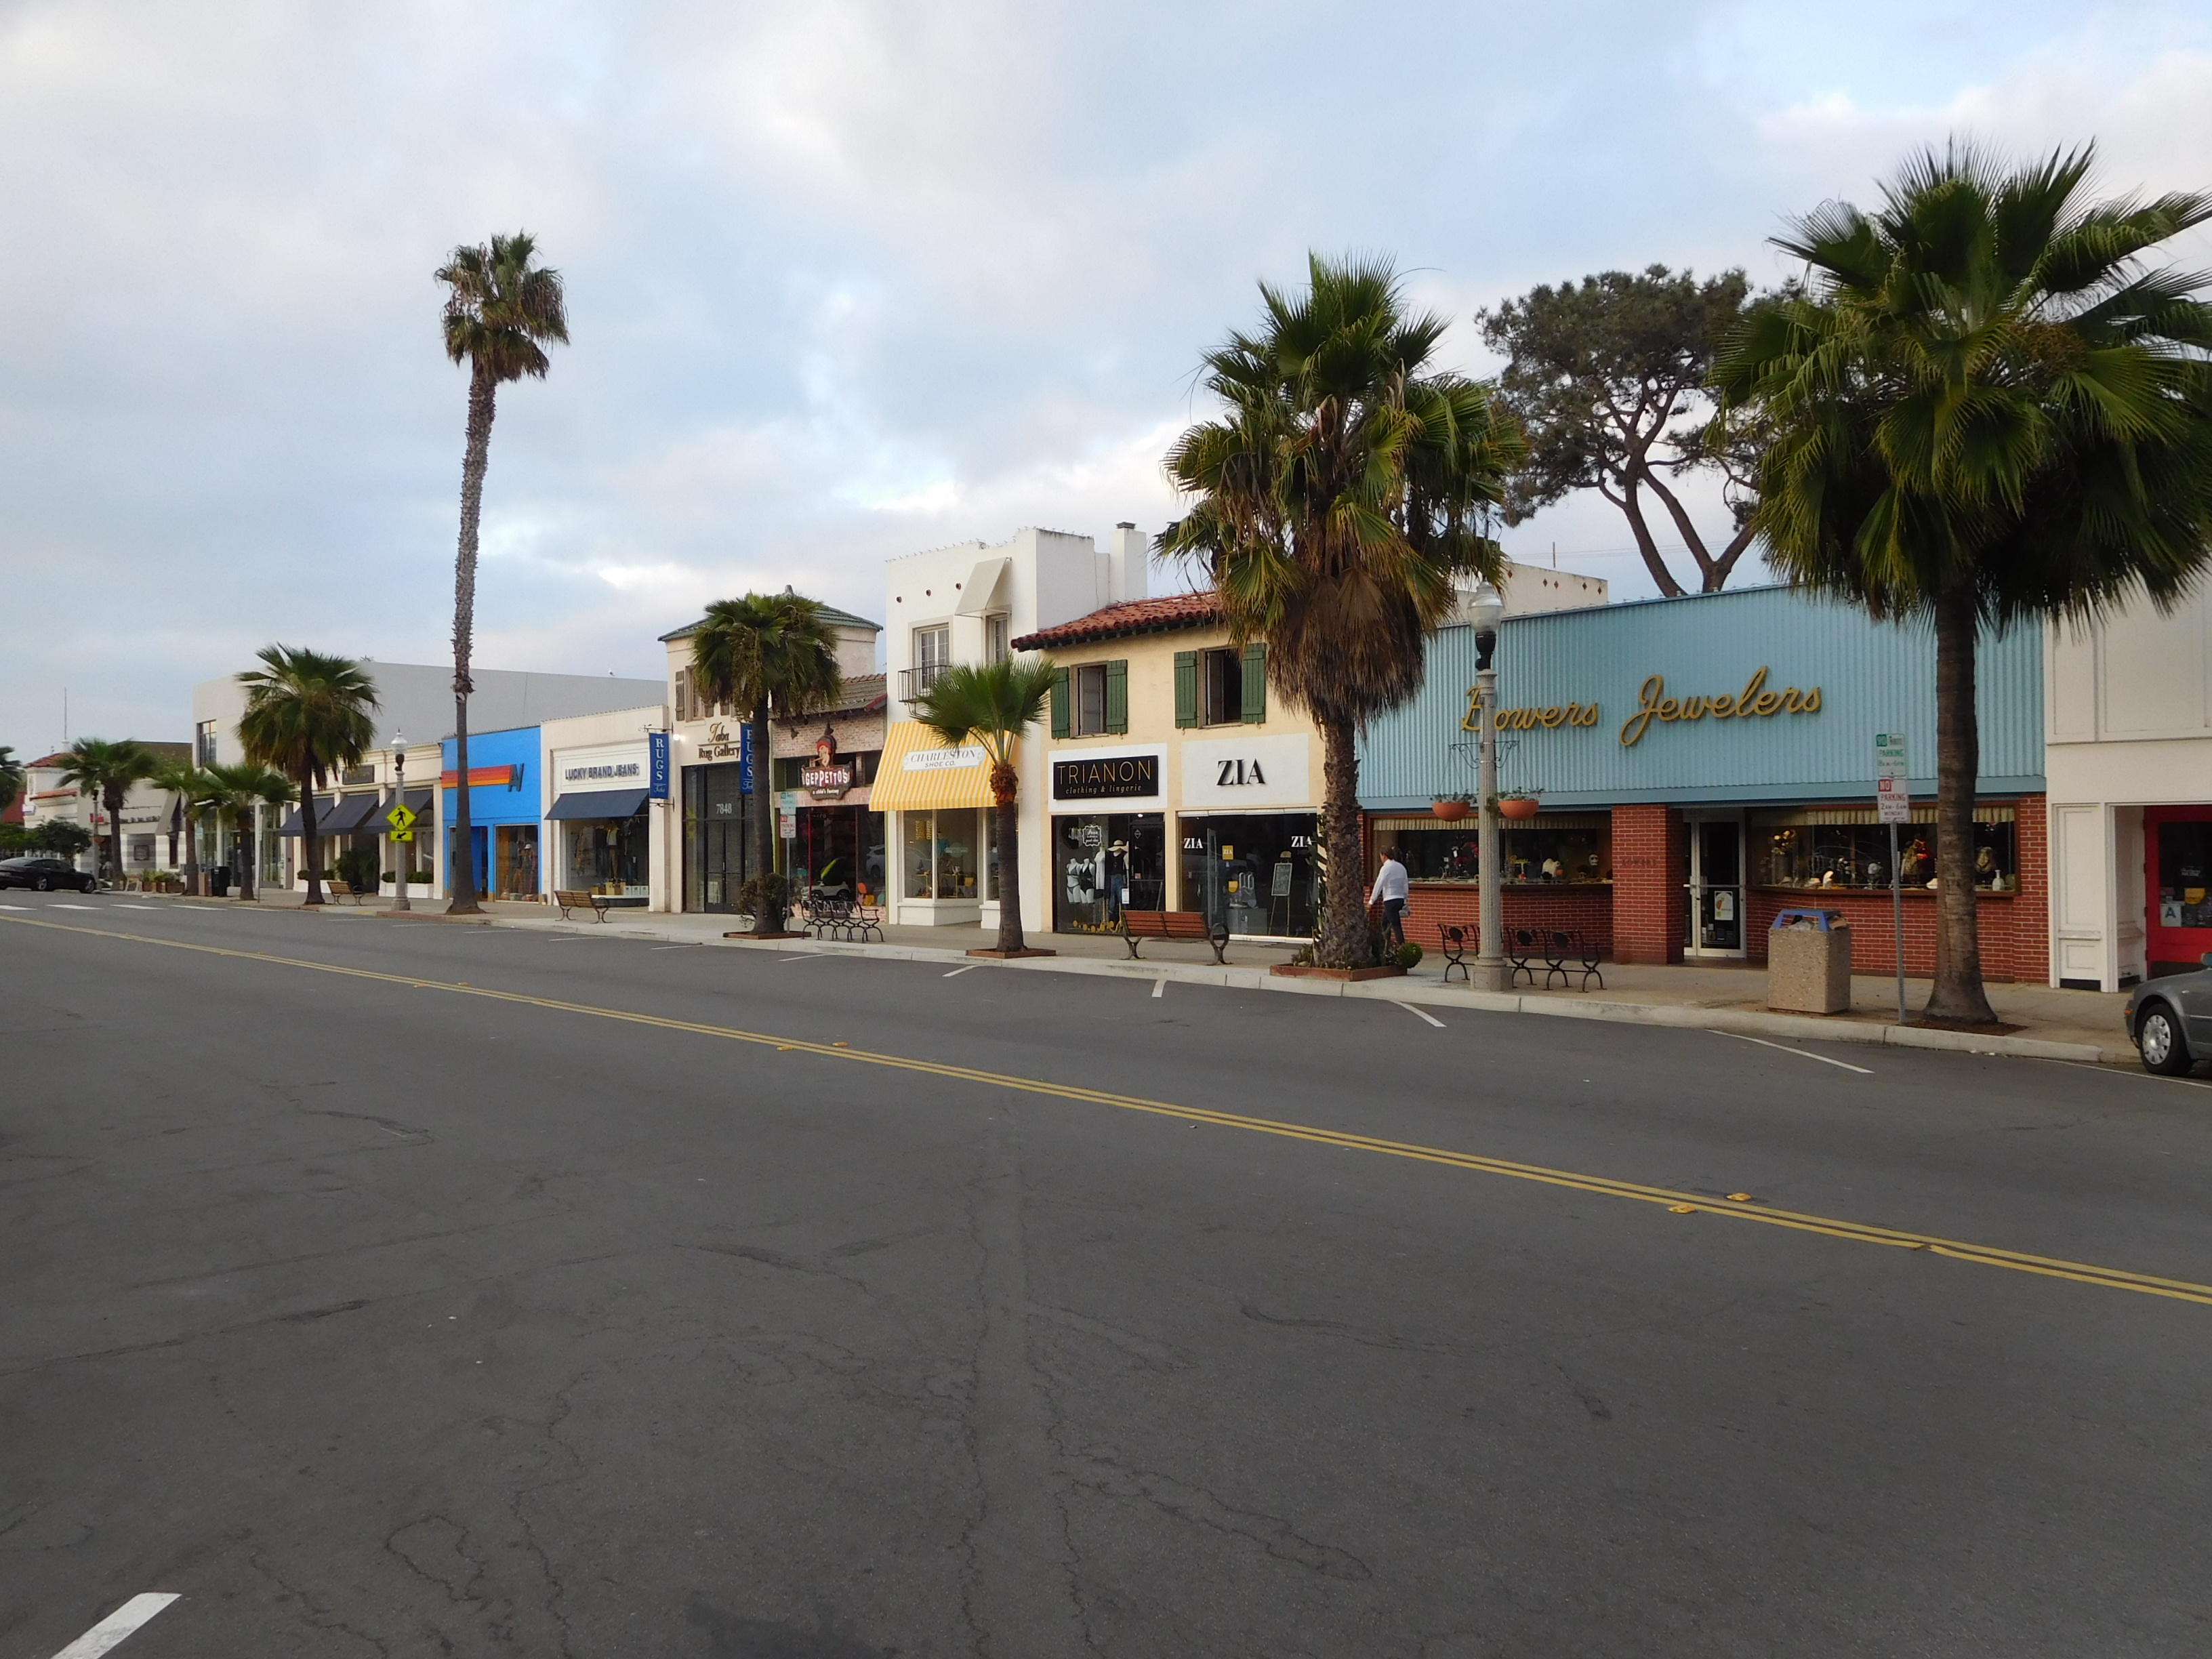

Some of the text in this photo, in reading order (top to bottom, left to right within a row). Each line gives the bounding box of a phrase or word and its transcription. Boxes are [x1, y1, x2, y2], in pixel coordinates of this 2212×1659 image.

[1619, 666, 1822, 746] Jewelers
[655, 738, 664, 781] RUGS
[698, 745, 740, 761] Rug Gallery
[565, 763, 639, 780] LUCKY BRAND JEANS
[805, 769, 848, 787] GEPPETTO'S
[1057, 760, 1151, 785] TRIANON
[1216, 758, 1265, 786] ZIA
[1065, 786, 1097, 795] clothing
[1109, 783, 1142, 794] lingerie
[1879, 781, 1891, 791] NO
[716, 803, 732, 814] 7848
[1183, 838, 1204, 849] ZIA
[1291, 836, 1313, 848] ZIA
[2165, 907, 2176, 918] A
